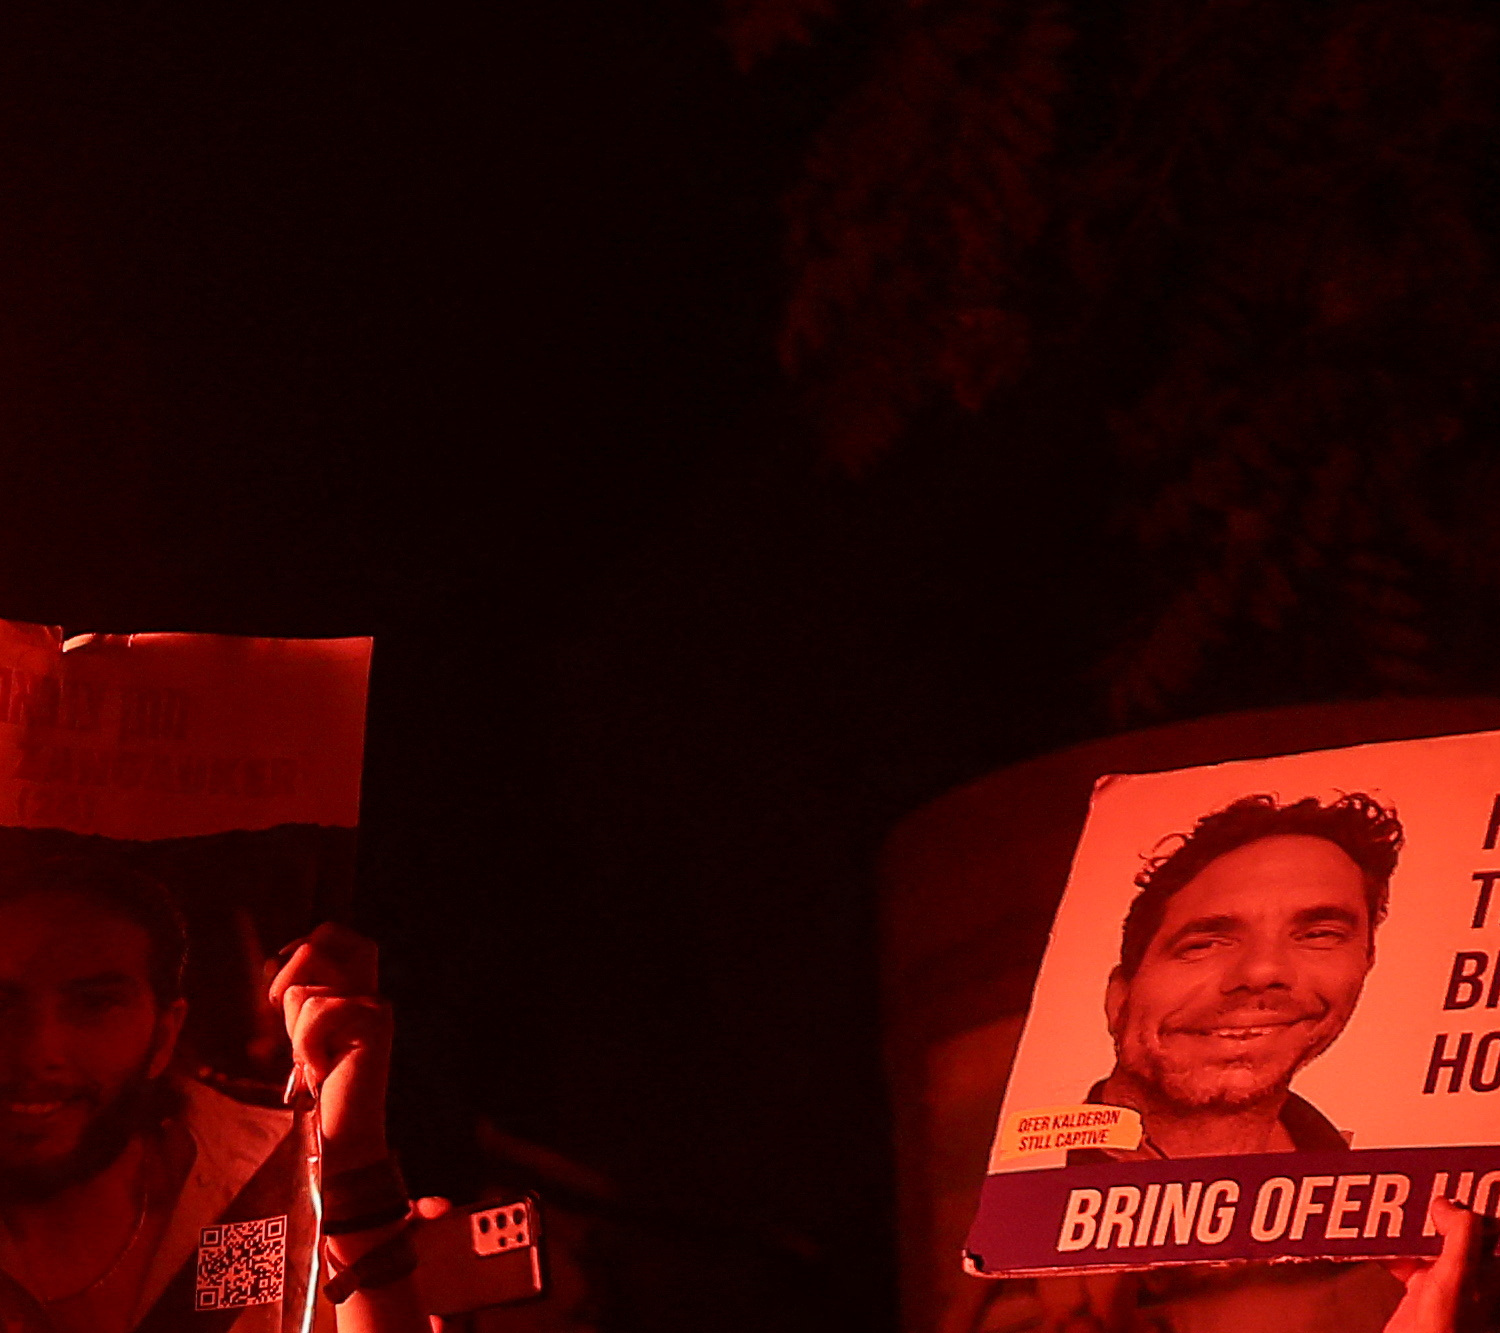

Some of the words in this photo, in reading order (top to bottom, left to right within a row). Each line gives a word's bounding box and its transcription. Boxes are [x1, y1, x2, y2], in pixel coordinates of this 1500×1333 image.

[1018, 1116, 1051, 1133] OFER
[1053, 1110, 1121, 1128] KALDERON
[1018, 1135, 1051, 1152] STILL
[1055, 1129, 1109, 1148] CAPTIVE
[1057, 1181, 1240, 1253] BRING
[1251, 1174, 1407, 1243] OFER
